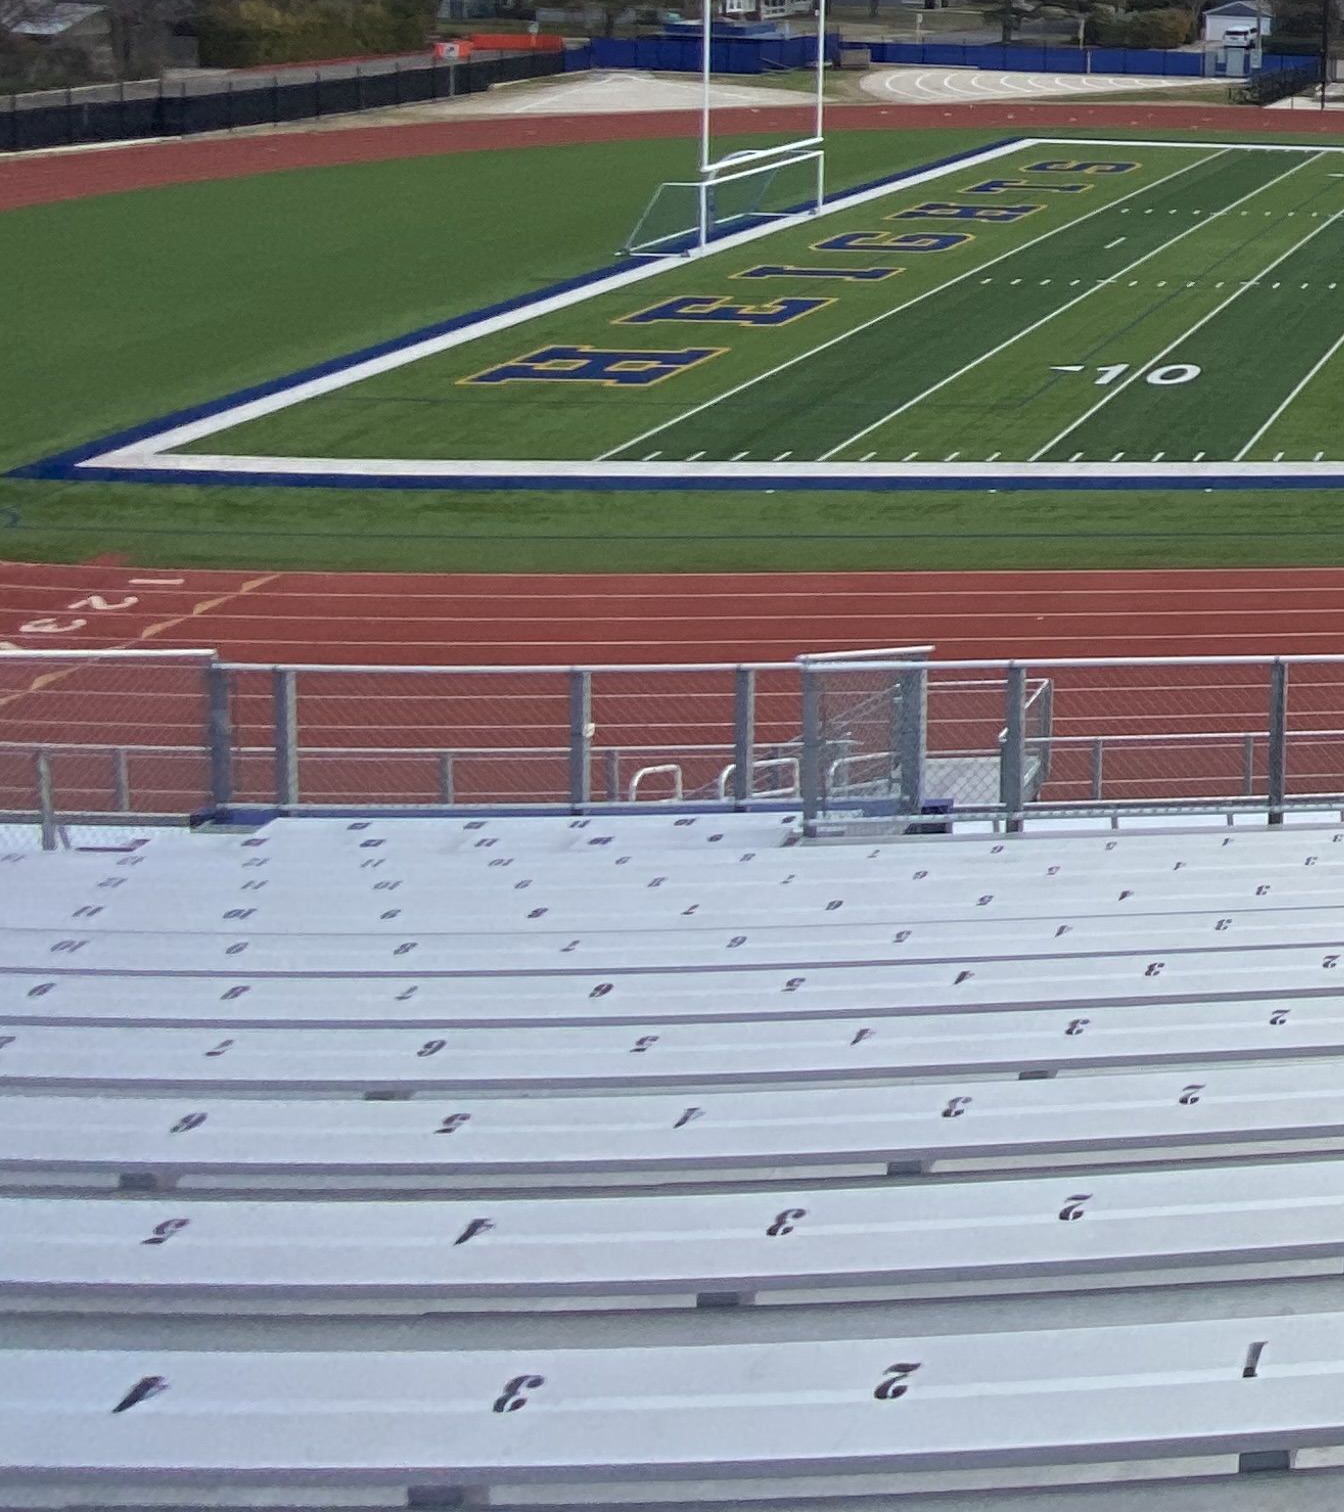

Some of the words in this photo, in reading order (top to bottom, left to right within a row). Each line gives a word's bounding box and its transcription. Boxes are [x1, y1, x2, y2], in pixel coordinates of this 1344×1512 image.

[455, 160, 1144, 386] HEIGHTS
[1094, 363, 1202, 386] 10
[67, 595, 138, 610] 2
[19, 617, 88, 633] 3
[1173, 862, 1186, 871] 4
[1304, 856, 1318, 866] 3
[913, 871, 928, 880] 6
[1045, 866, 1060, 875] 5
[780, 875, 796, 884] 7
[1118, 890, 1134, 901] 4
[1255, 885, 1270, 896] 3
[825, 900, 844, 911] 6
[976, 895, 994, 906] 5
[525, 908, 549, 919] 8
[680, 904, 699, 915] 7
[1055, 925, 1073, 938] 4
[1214, 919, 1232, 931] 3
[726, 936, 747, 948] 6
[892, 930, 912, 944] 5
[225, 942, 249, 957] 9
[393, 942, 419, 955] 8
[559, 940, 580, 952] 7
[1143, 963, 1165, 976] 3
[1322, 955, 1341, 969] 2
[781, 978, 806, 992] 5
[952, 970, 975, 985] 4
[27, 982, 57, 998] 9
[220, 985, 250, 1000] 8
[394, 986, 418, 1001] 7
[588, 983, 614, 998] 6
[1269, 1009, 1291, 1025] 2
[1064, 1019, 1091, 1036] 3
[850, 1028, 876, 1046] 4
[204, 1040, 235, 1057] 7
[416, 1040, 447, 1057] 6
[629, 1036, 660, 1055] 5
[1177, 1084, 1206, 1105] 2
[941, 1097, 973, 1118] 3
[169, 1112, 208, 1136] 6
[433, 1113, 471, 1134] 5
[672, 1107, 706, 1129] 4
[1058, 1193, 1093, 1221] 2
[766, 1208, 810, 1237] 3
[139, 1218, 191, 1246] 5
[453, 1218, 496, 1246] 4
[1241, 1341, 1268, 1379] 1
[873, 1363, 922, 1400] 2
[110, 1376, 171, 1414] 4
[492, 1375, 546, 1414] 3
